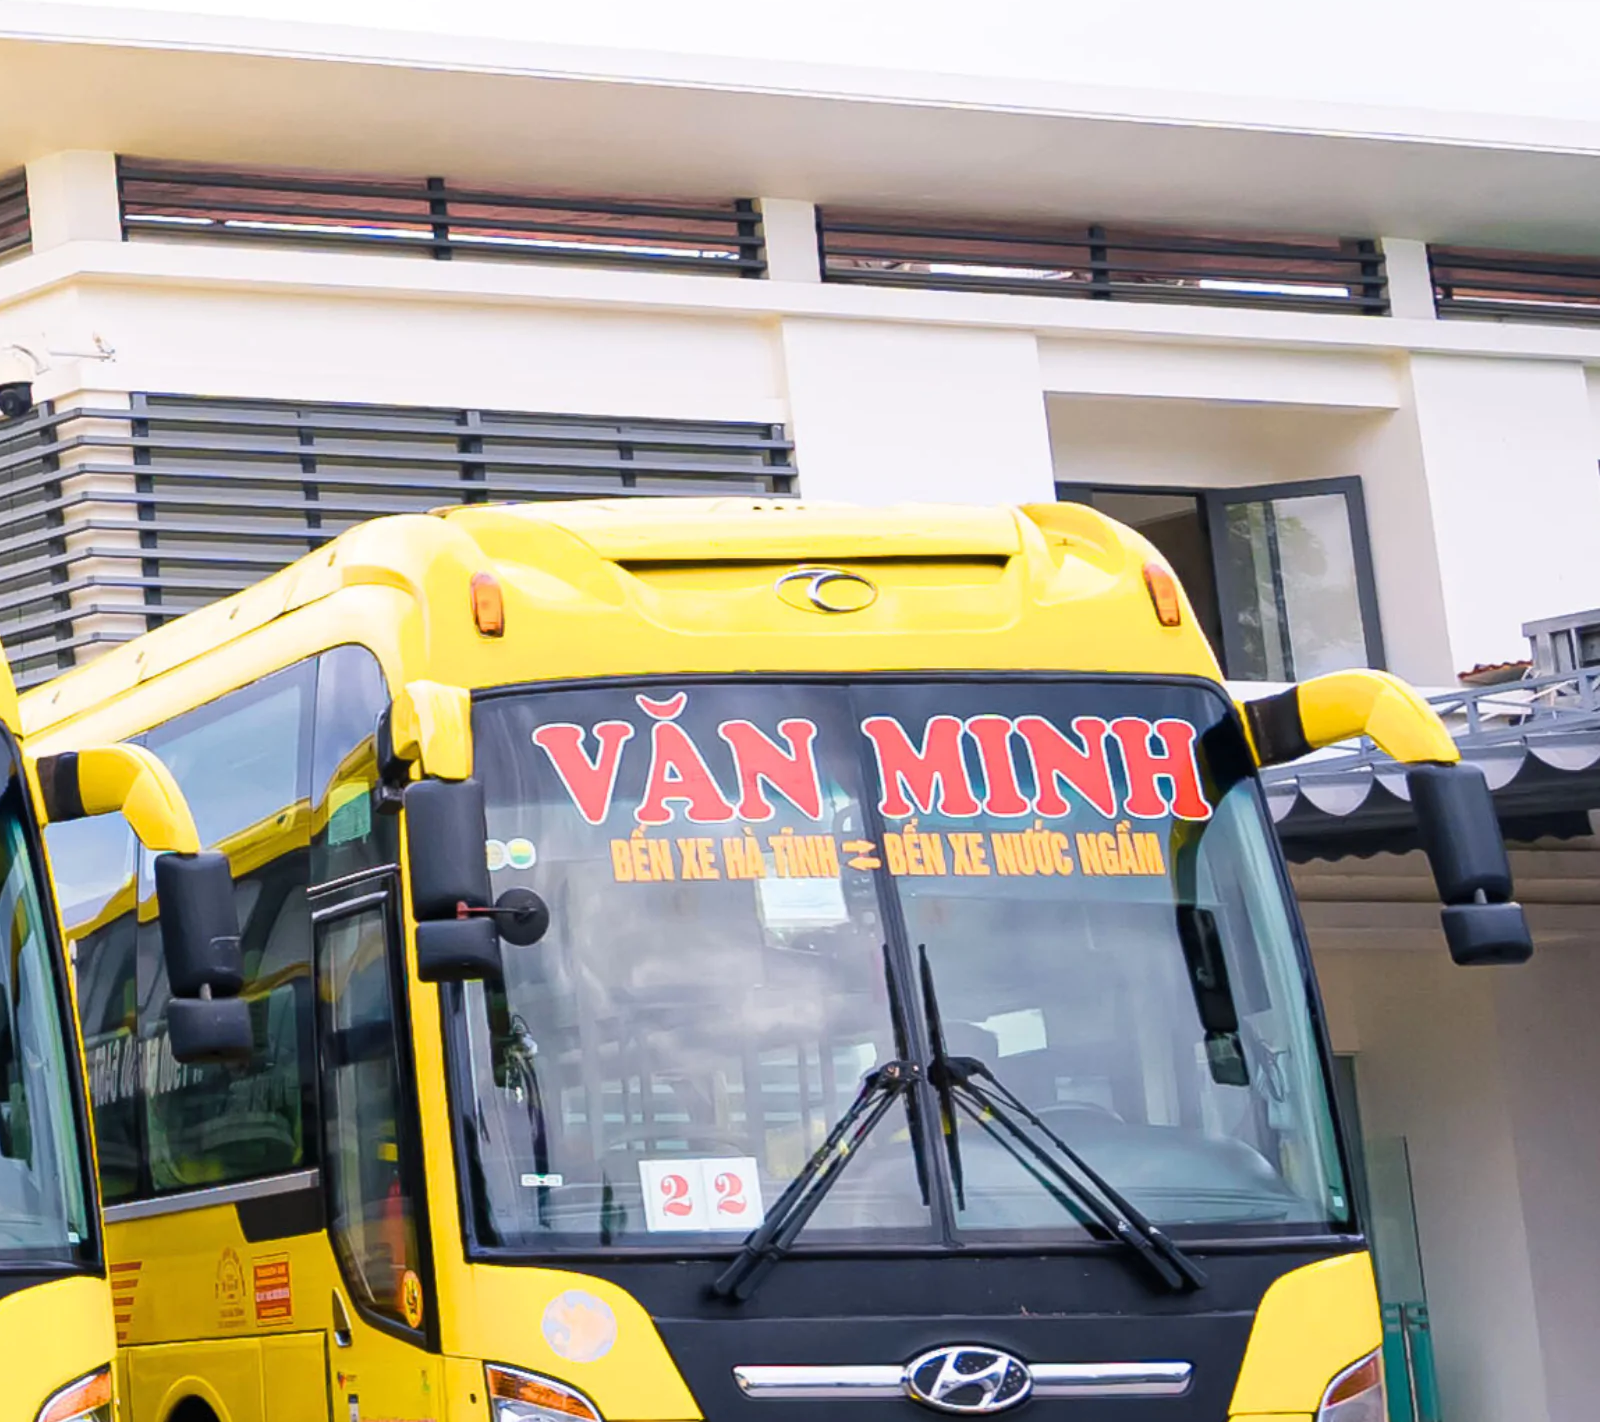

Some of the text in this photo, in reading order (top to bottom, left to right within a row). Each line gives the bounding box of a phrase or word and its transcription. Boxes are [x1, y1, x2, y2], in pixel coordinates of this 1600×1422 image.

[532, 691, 1213, 825] VĂN MINH
[610, 824, 674, 882] BẾN
[676, 837, 720, 880] XE
[722, 827, 766, 879] HÀ
[768, 826, 840, 878] TĨNH
[883, 818, 946, 875] BẾN
[947, 832, 991, 875] XE
[990, 819, 1073, 875] NƯỚC
